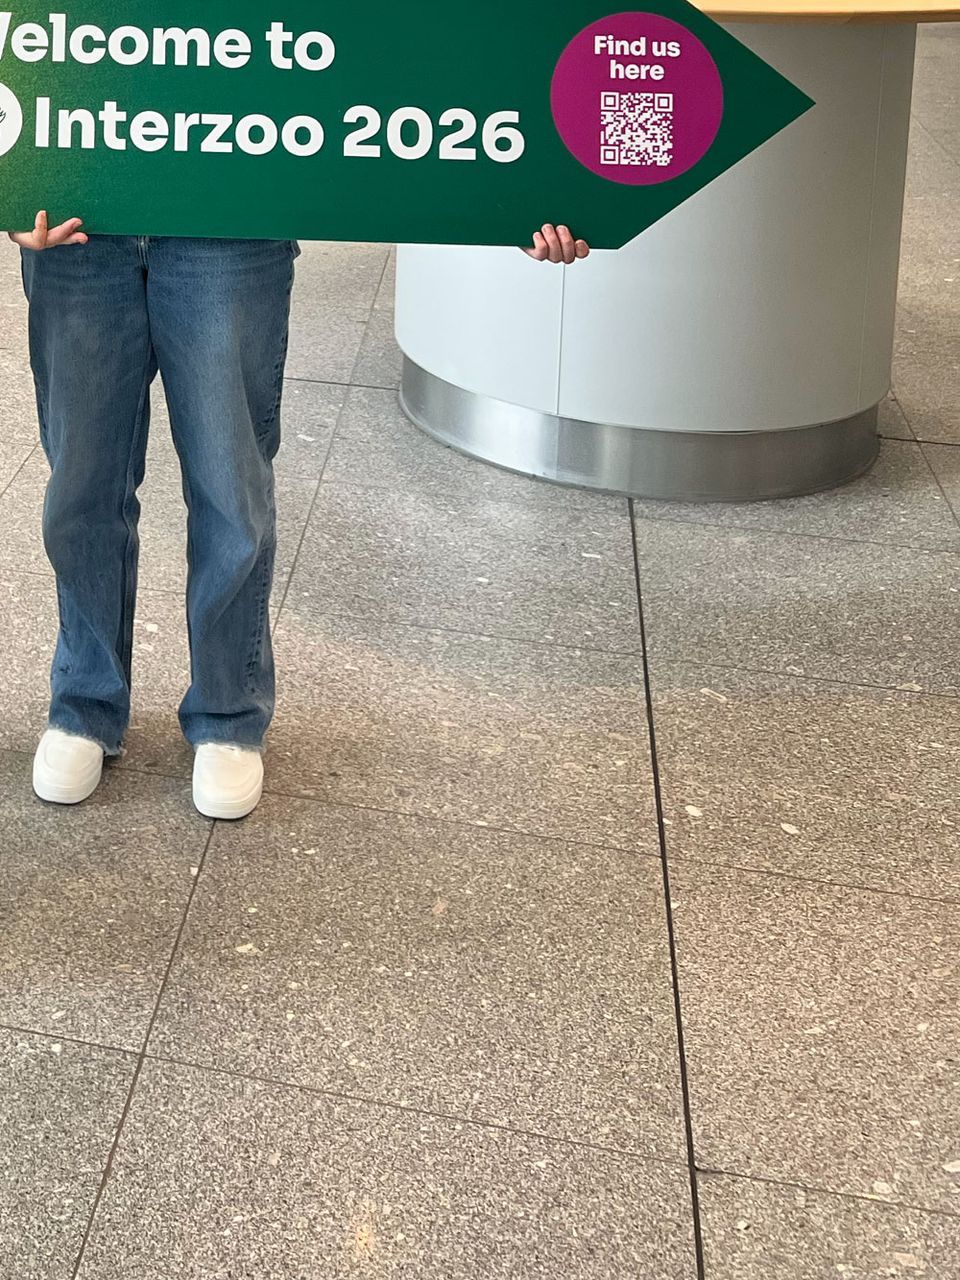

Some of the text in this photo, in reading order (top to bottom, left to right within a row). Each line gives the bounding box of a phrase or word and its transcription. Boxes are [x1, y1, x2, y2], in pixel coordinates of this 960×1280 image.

[265, 21, 336, 72] to
[594, 35, 681, 58] Find us
[610, 60, 665, 80] here
[34, 96, 526, 163] Interzoo 2026
